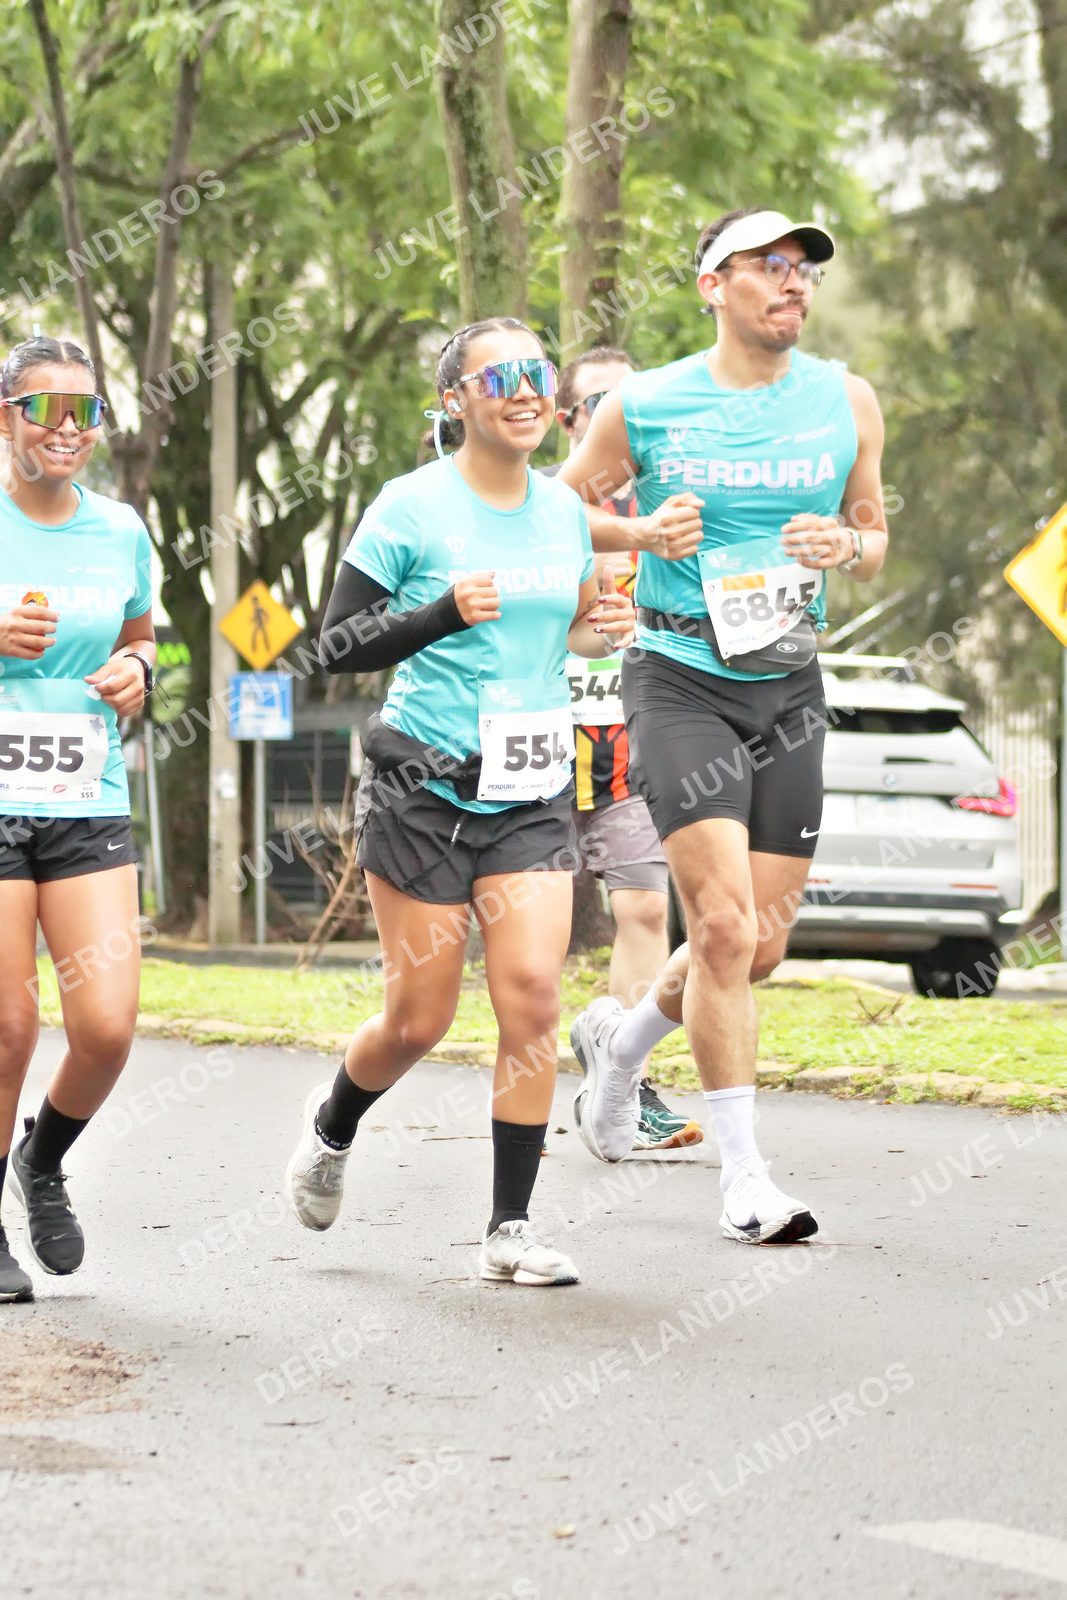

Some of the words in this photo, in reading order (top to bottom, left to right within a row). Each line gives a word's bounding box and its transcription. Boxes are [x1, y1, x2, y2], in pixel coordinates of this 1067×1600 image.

[659, 452, 836, 489] PERDURA
[721, 581, 816, 627] 6845
[0, 734, 84, 773] 555
